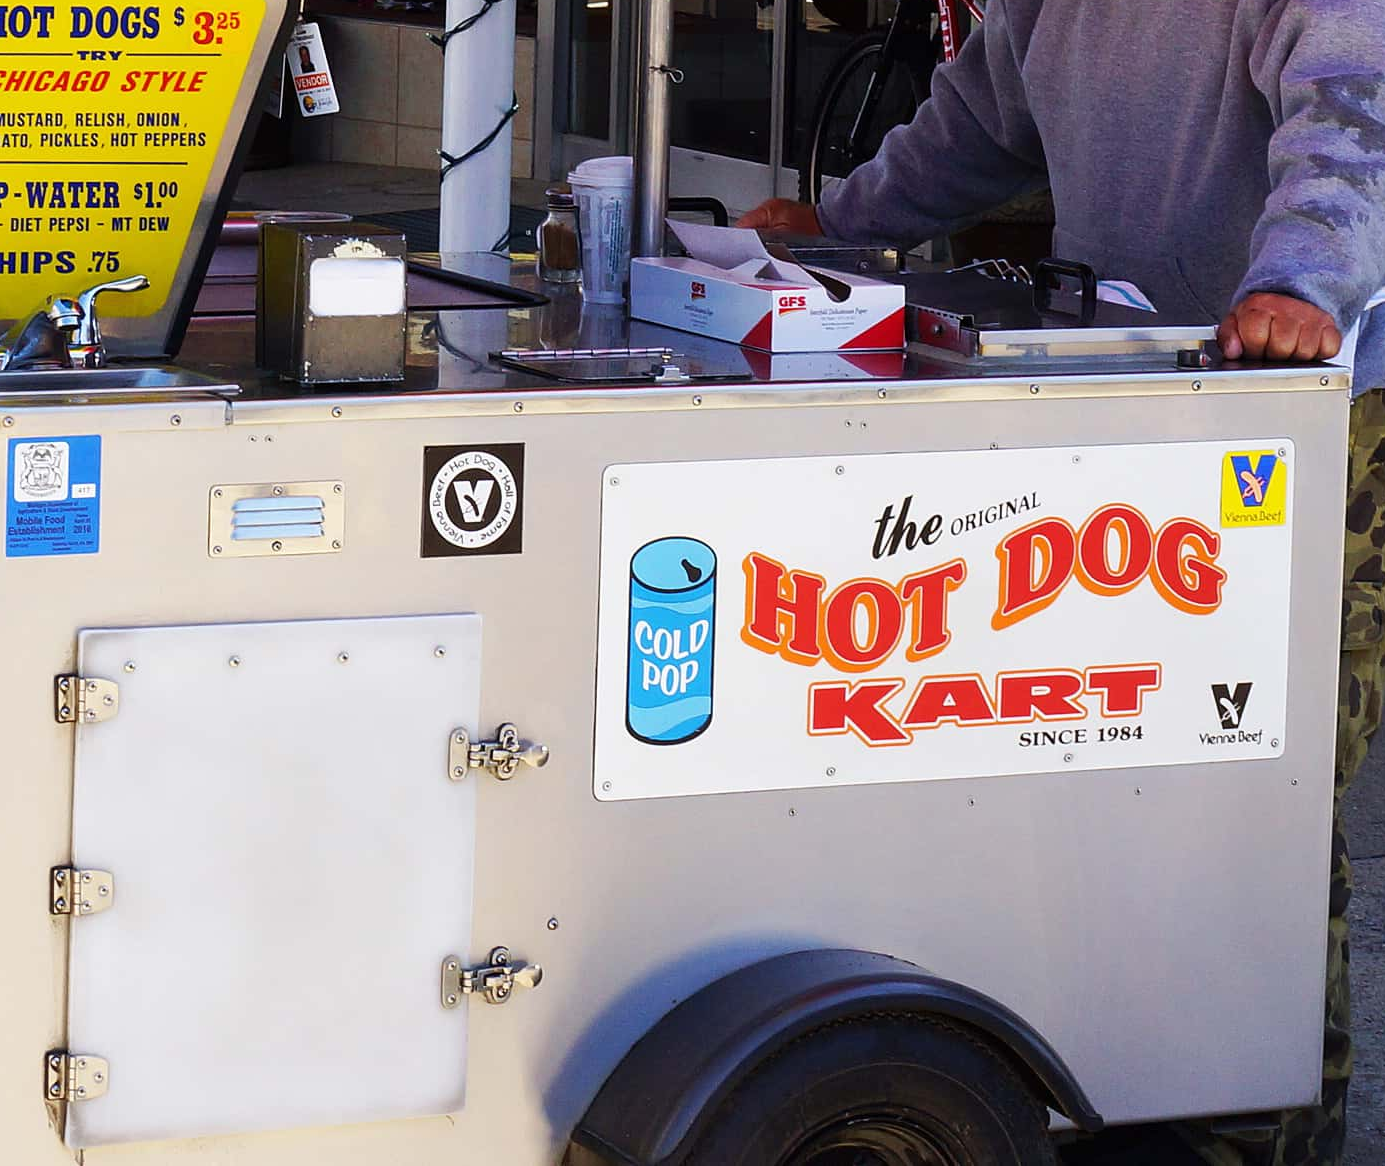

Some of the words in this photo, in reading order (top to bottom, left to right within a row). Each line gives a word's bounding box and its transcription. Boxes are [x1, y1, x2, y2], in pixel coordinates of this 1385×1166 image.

[70, 6, 160, 39] DOGS
[76, 50, 123, 61] TRY
[120, 71, 207, 92] STYLE
[296, 74, 329, 90] VENDOR
[75, 113, 130, 129] RELISH,
[40, 133, 105, 149] PICKLES,
[111, 133, 137, 147] HOT
[144, 132, 207, 147] PEPPERS
[10, 218, 43, 232] DIET
[49, 218, 90, 232] PEPSI
[111, 217, 133, 232] MT
[139, 217, 170, 232] DEW
[86, 251, 120, 272] .75
[778, 296, 807, 307] GFS
[448, 458, 470, 472] Hot
[474, 454, 496, 471] Dog
[433, 478, 446, 507] Beef
[502, 474, 514, 497] Hall
[503, 501, 511, 514] of
[1224, 512, 1257, 522] Vienna
[1259, 510, 1281, 523] Beef
[8, 525, 65, 535] Establishment
[16, 517, 43, 525] Mobile
[45, 515, 65, 524] Food
[436, 510, 464, 545] Vienna
[480, 516, 508, 540] Fame
[871, 495, 943, 560] the
[951, 492, 1041, 536] ORIGINAL
[741, 551, 966, 673] HOT
[991, 503, 1227, 631] DOG
[635, 619, 709, 662] COLD
[642, 659, 699, 697] POP
[807, 663, 1162, 748] KART
[1018, 729, 1087, 748] SINCE
[1097, 725, 1144, 744] 1984
[1199, 733, 1236, 745] Vienna
[1238, 729, 1263, 745] Beef
